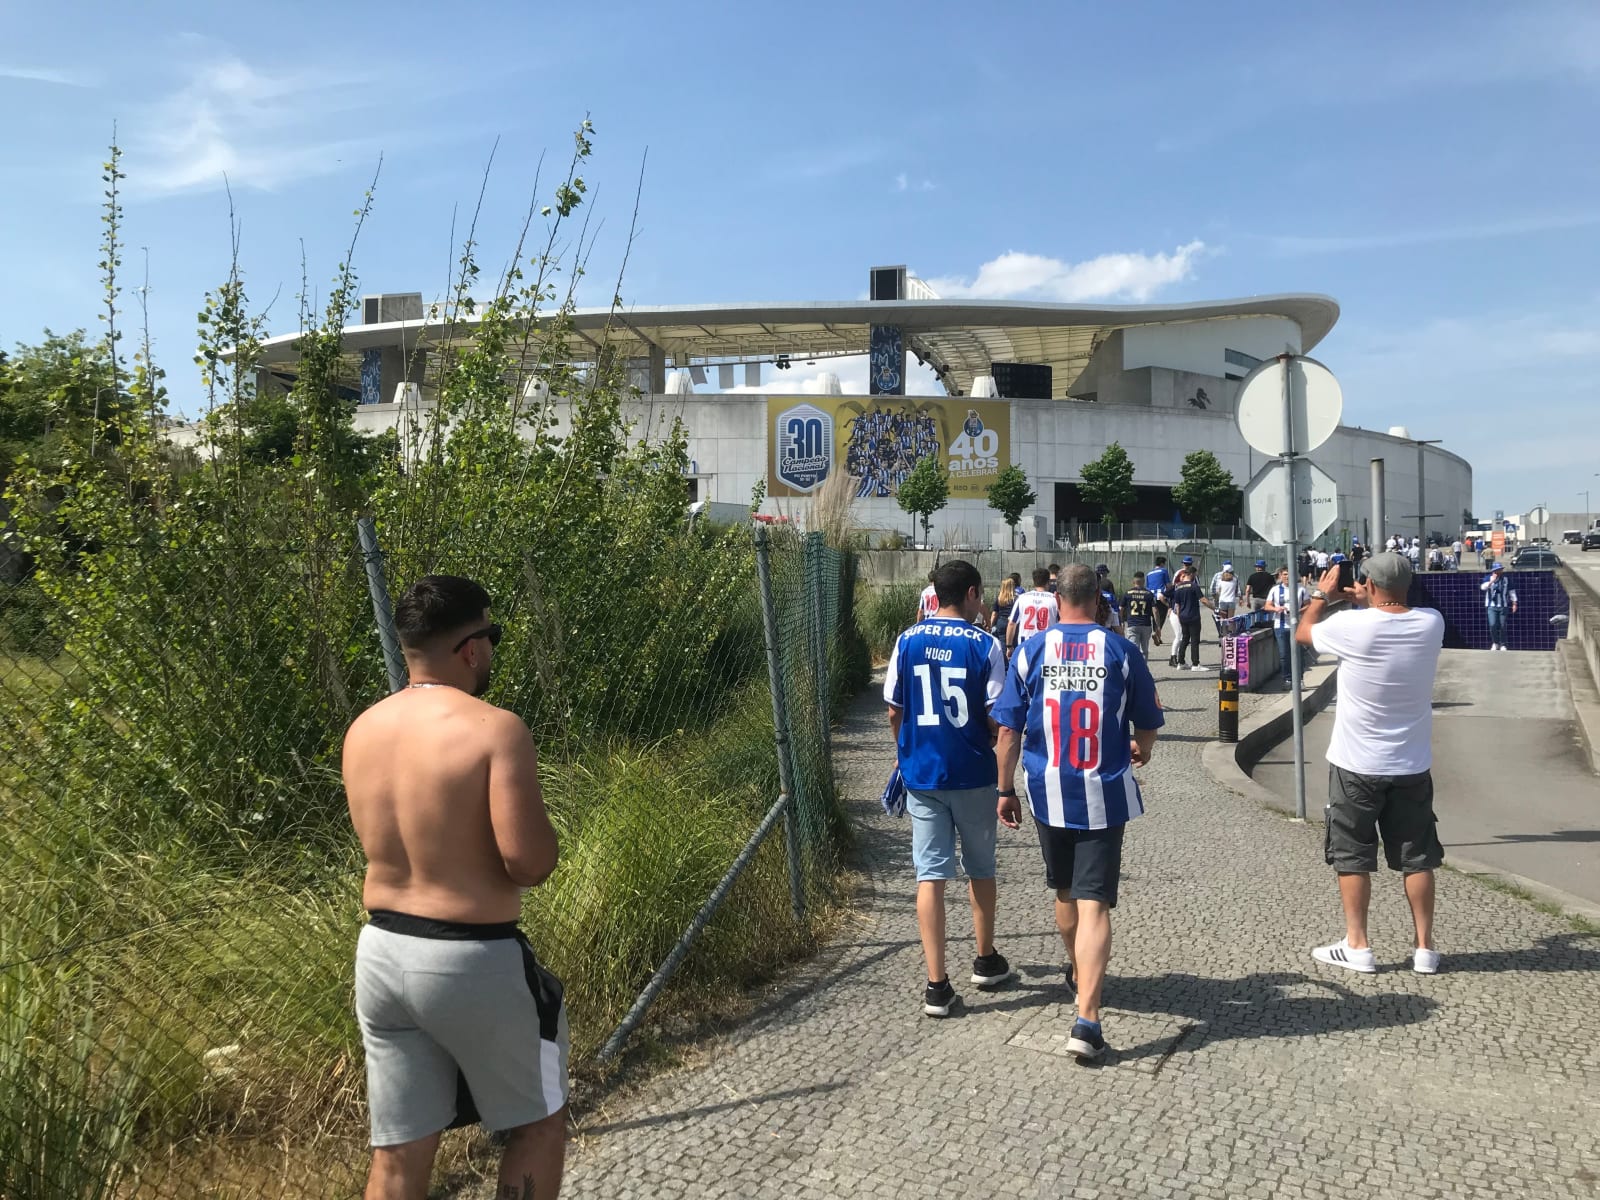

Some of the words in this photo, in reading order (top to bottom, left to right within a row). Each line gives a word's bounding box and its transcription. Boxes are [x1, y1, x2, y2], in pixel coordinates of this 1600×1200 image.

[787, 418, 823, 459] 30
[949, 429, 999, 459] 40
[783, 461, 825, 473] Nacional
[948, 457, 999, 471] anos
[957, 468, 998, 478] CELEBRAR
[1130, 600, 1147, 616] 27
[1023, 605, 1049, 631] 29
[904, 624, 941, 640] SUPER
[943, 625, 983, 642] BOCK
[924, 646, 953, 662] HUGO
[1054, 642, 1096, 661] VITOR
[1042, 665, 1108, 679] ESPIRITO
[1050, 679, 1098, 691] SANTO
[913, 663, 969, 729] 15
[1045, 698, 1100, 769] 18
